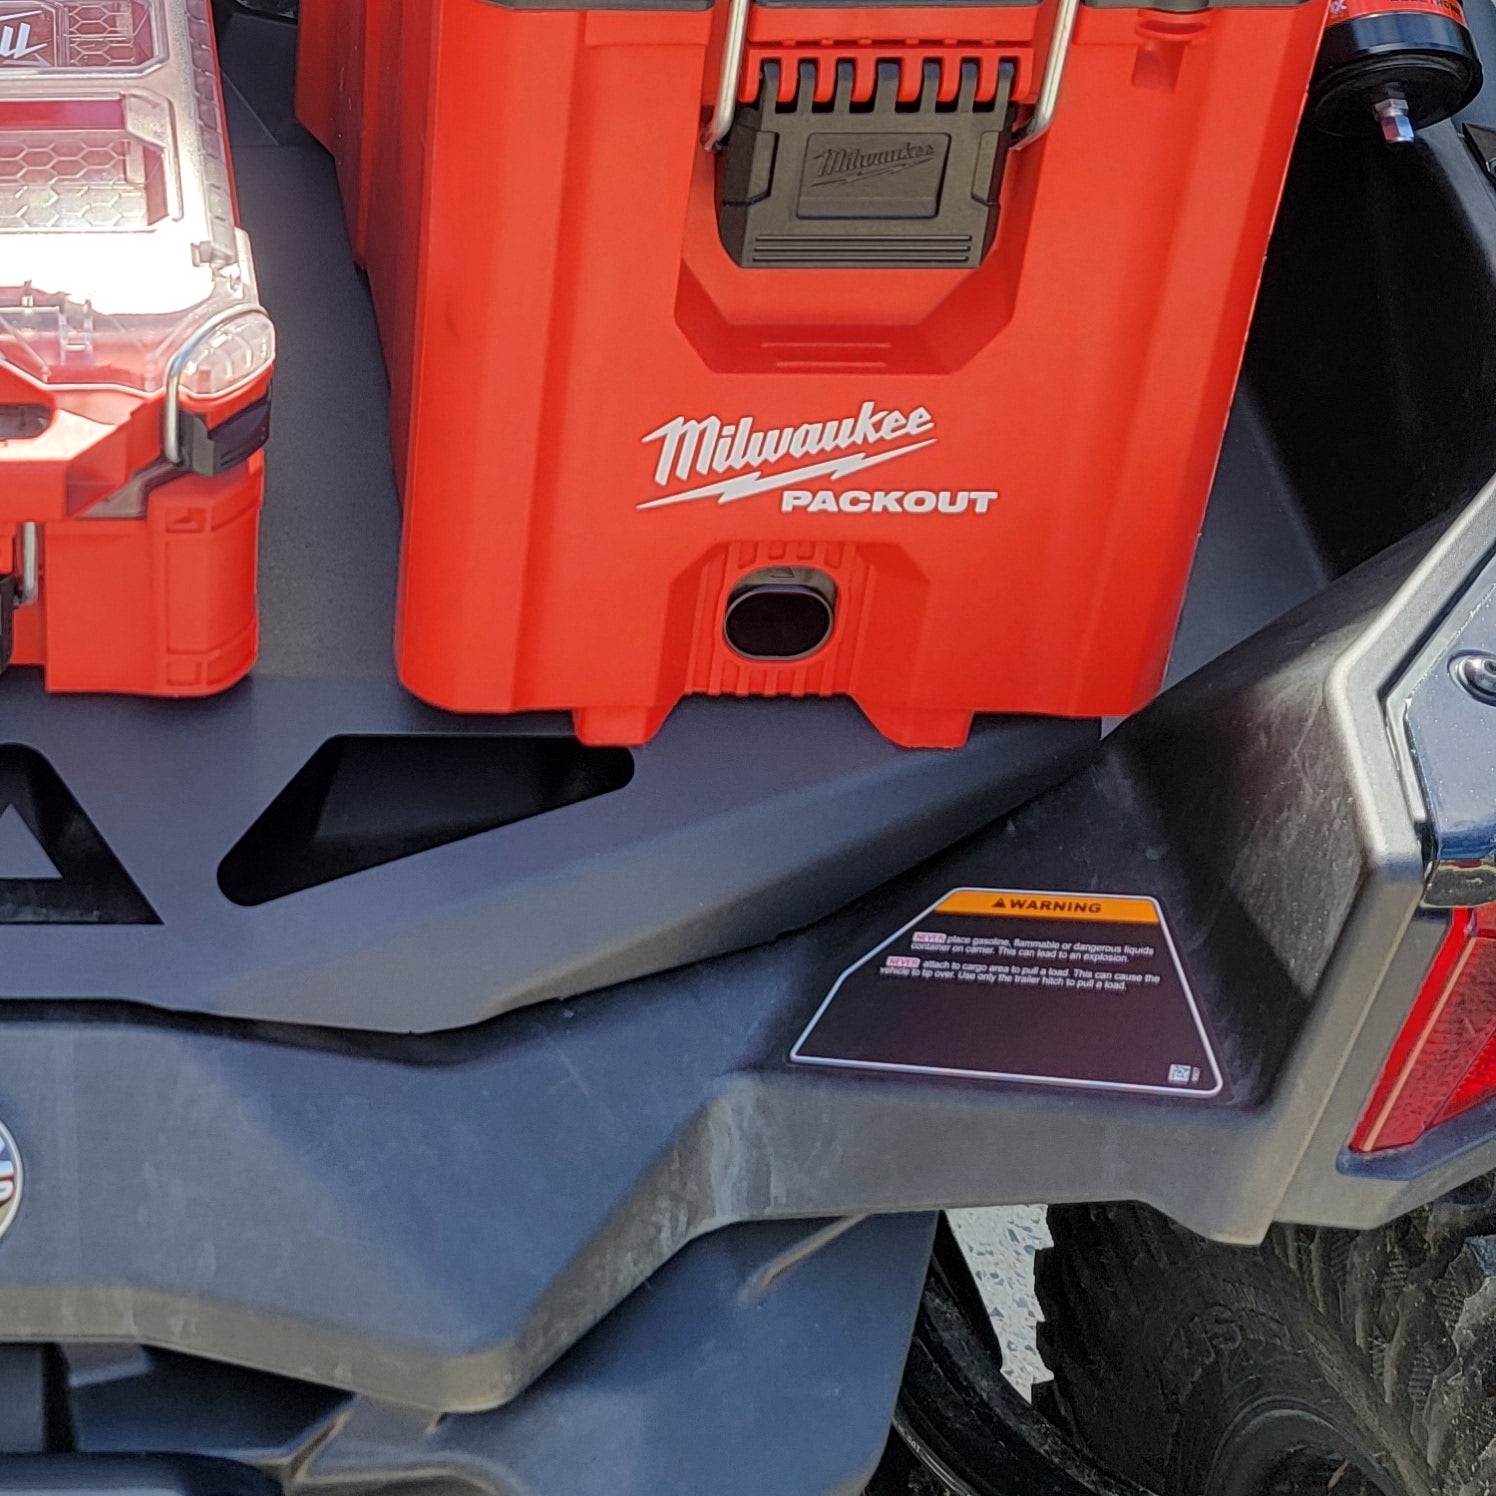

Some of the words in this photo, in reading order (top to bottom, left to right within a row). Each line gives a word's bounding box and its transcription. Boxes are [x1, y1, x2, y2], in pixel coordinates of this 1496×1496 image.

[642, 402, 935, 486] Milwaukee
[781, 491, 998, 513] PACKOUT
[1010, 899, 1102, 913] WARNING
[911, 942, 951, 952] container
[952, 945, 964, 953] on
[998, 946, 1017, 956] This
[1018, 949, 1035, 958] can
[1058, 950, 1067, 959] to
[1083, 952, 1130, 965] explosion.
[915, 934, 944, 942] NEVER
[947, 935, 971, 945] place
[972, 937, 1011, 948] gasoline,
[1014, 938, 1060, 949] flammable
[1062, 942, 1072, 950] or
[1073, 942, 1122, 955] dangerous
[1124, 945, 1154, 957] liquids
[890, 958, 919, 967] NEVER
[923, 960, 950, 970] attach
[951, 961, 961, 971] to
[962, 963, 988, 973] cargo
[989, 964, 1010, 974] area
[1011, 965, 1021, 974] to
[1022, 966, 1039, 976] pull
[1040, 968, 1047, 976] a
[1048, 967, 1071, 977] load.
[1073, 968, 1093, 979] This
[1095, 971, 1113, 980] can
[1114, 972, 1143, 982] cause
[1144, 972, 1161, 983] the
[911, 967, 921, 976] to
[922, 968, 933, 979] tip
[934, 970, 956, 979] over.
[957, 971, 976, 980] Use
[977, 971, 997, 983] only
[998, 973, 1013, 982] the
[1014, 974, 1041, 985] trailer
[1042, 975, 1066, 986] hitch
[1066, 977, 1076, 987] to
[1077, 977, 1095, 989] pull
[1104, 979, 1127, 991] load.
